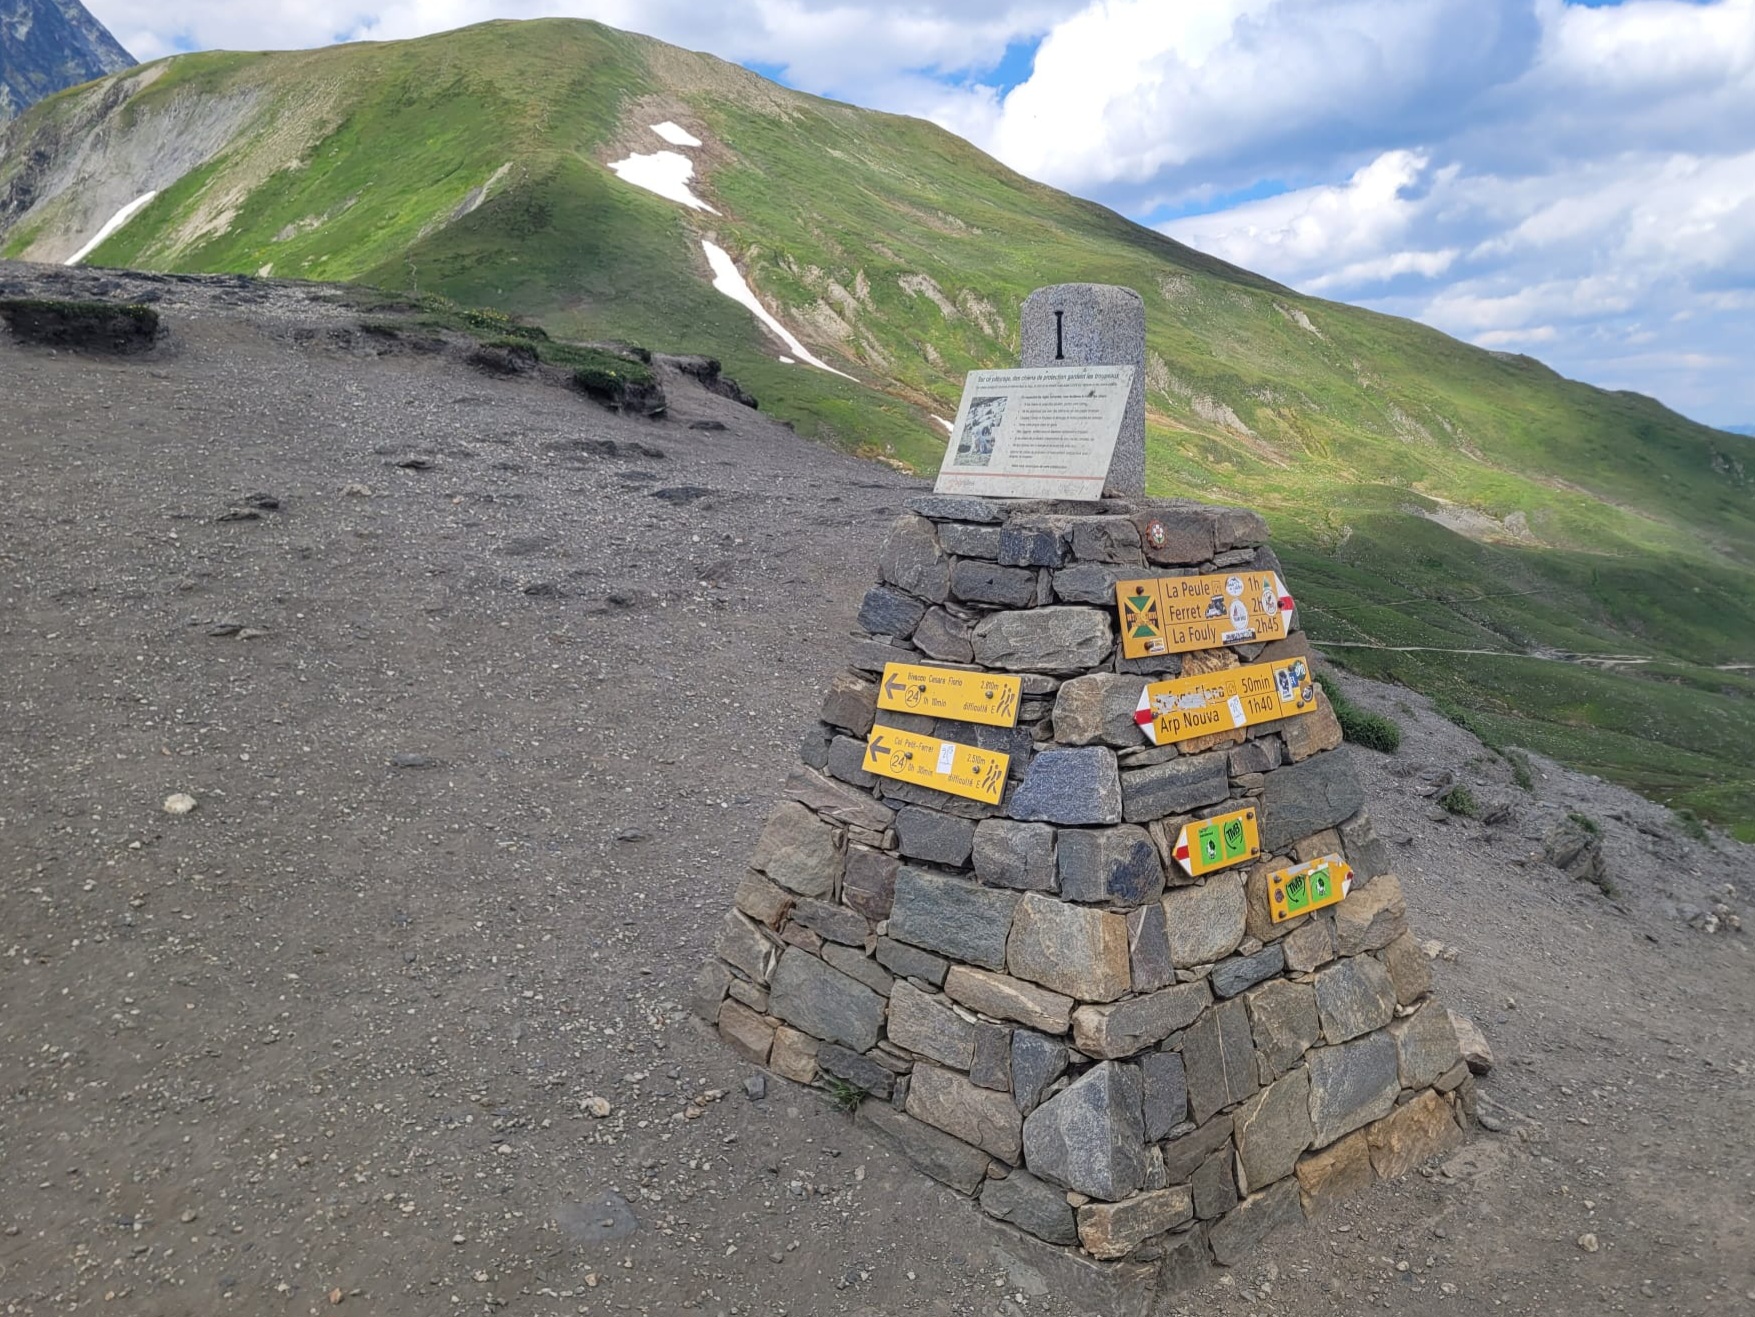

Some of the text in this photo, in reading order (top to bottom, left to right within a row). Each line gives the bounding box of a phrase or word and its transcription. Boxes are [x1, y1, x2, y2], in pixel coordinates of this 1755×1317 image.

[1166, 584, 1179, 599] La
[1181, 581, 1210, 597] Peule
[1247, 576, 1260, 592] 1h
[1169, 605, 1202, 621] Ferret
[1173, 629, 1186, 645] La
[1188, 624, 1216, 644] Fouly
[1255, 618, 1280, 635] 2h45
[1241, 675, 1271, 694] 50min
[906, 690, 919, 702] 24
[1161, 717, 1181, 735] Arp
[1184, 709, 1220, 728] Nouva
[1248, 696, 1273, 714] 1h40
[892, 754, 904, 769] 24
[1226, 822, 1241, 840] TMB
[1289, 875, 1303, 894] TMB
